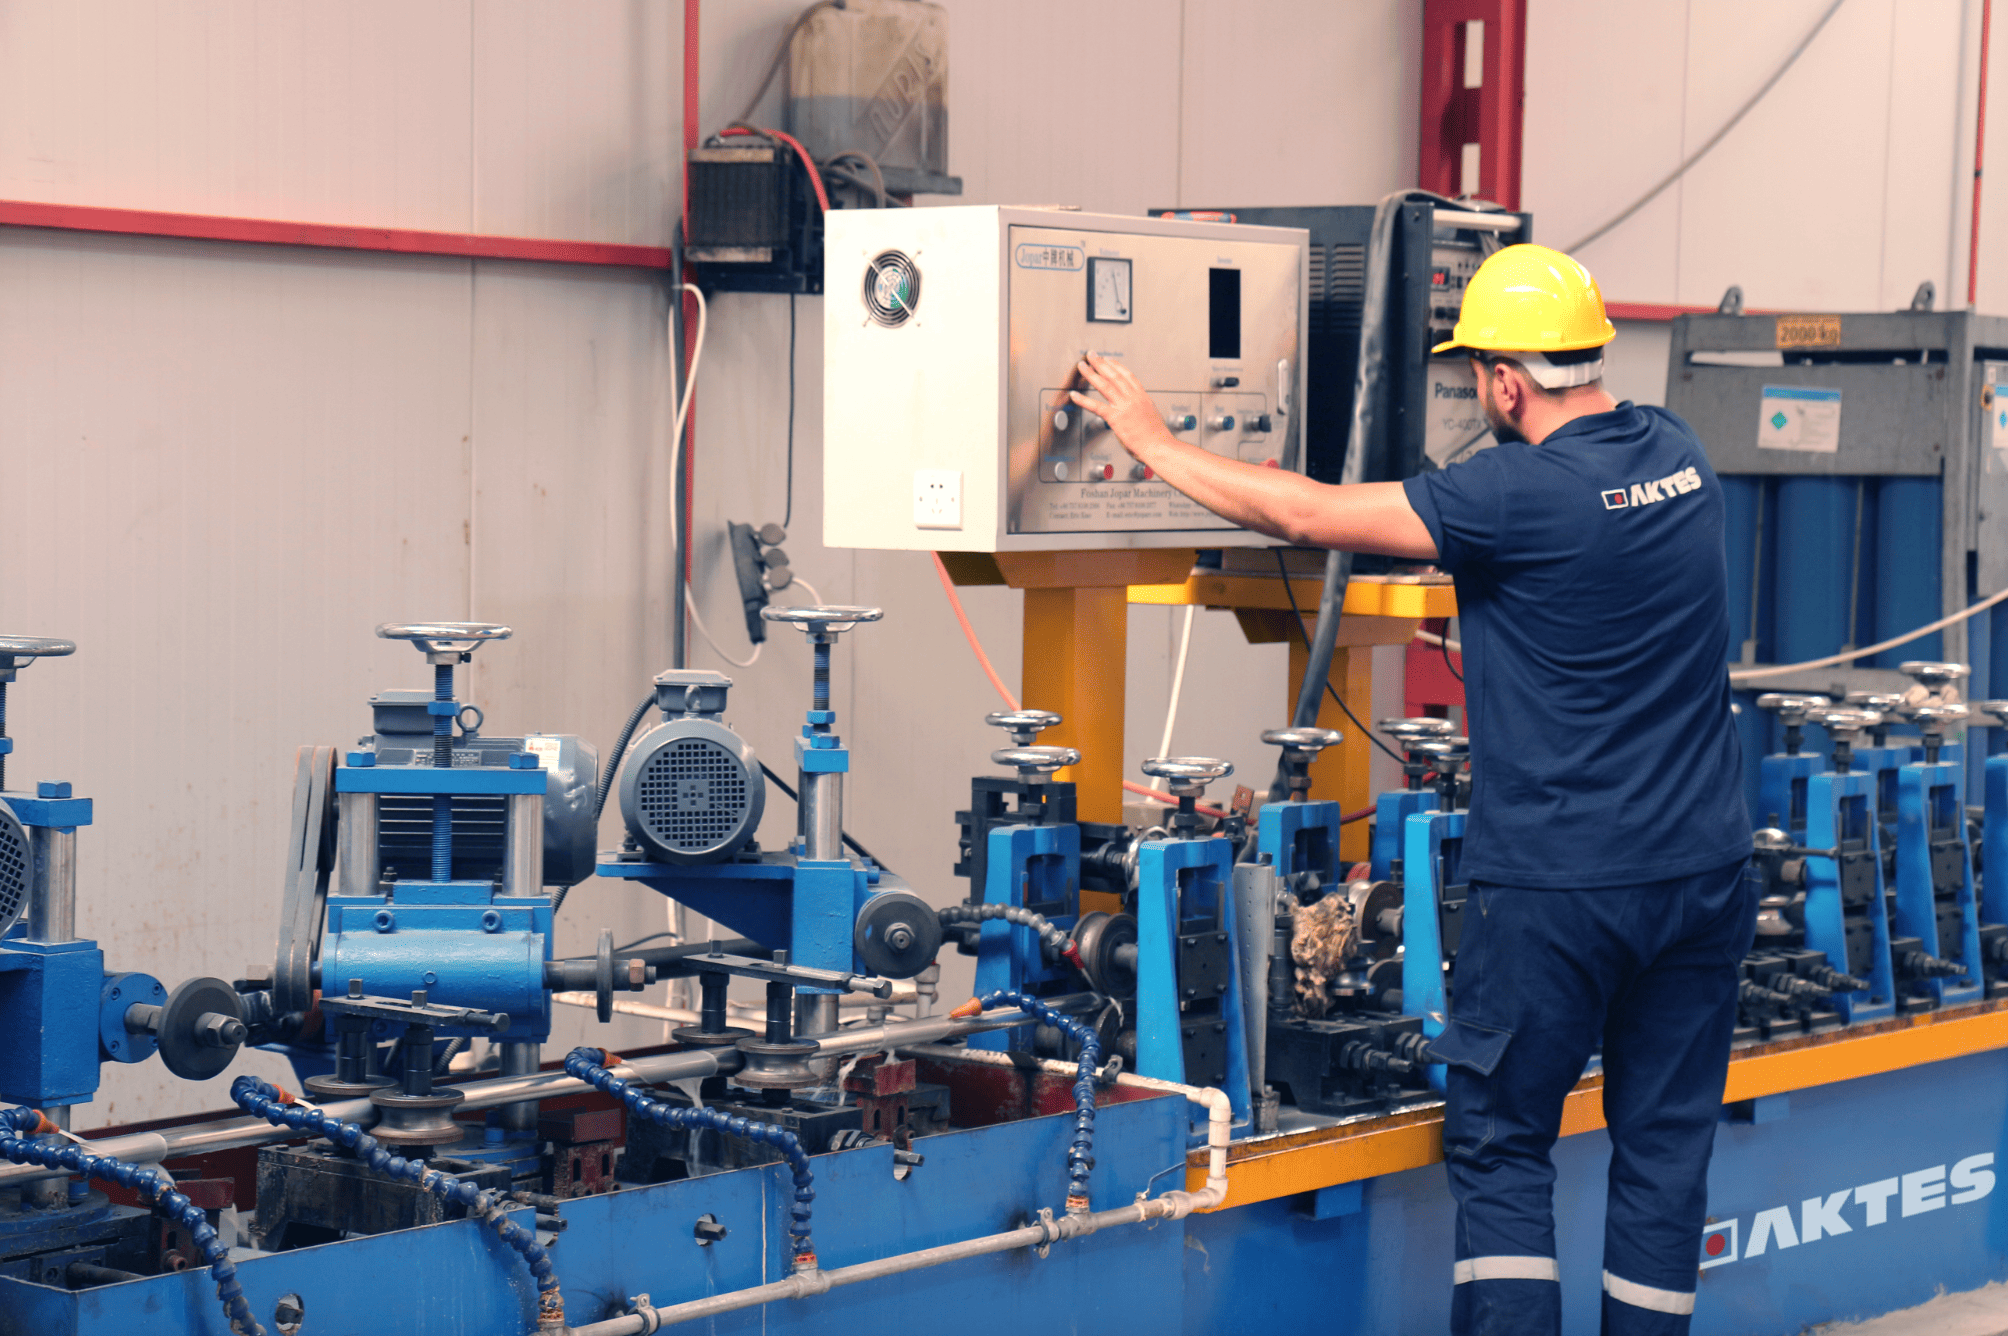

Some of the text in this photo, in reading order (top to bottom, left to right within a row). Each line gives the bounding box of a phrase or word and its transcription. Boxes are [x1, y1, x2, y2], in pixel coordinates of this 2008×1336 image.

[1780, 326, 1815, 342] 2000
[1080, 487, 1109, 499] Foshan
[1133, 487, 1172, 501] Machinery
[1630, 466, 1702, 507] AKTES
[1743, 1151, 1997, 1259] AKTES
